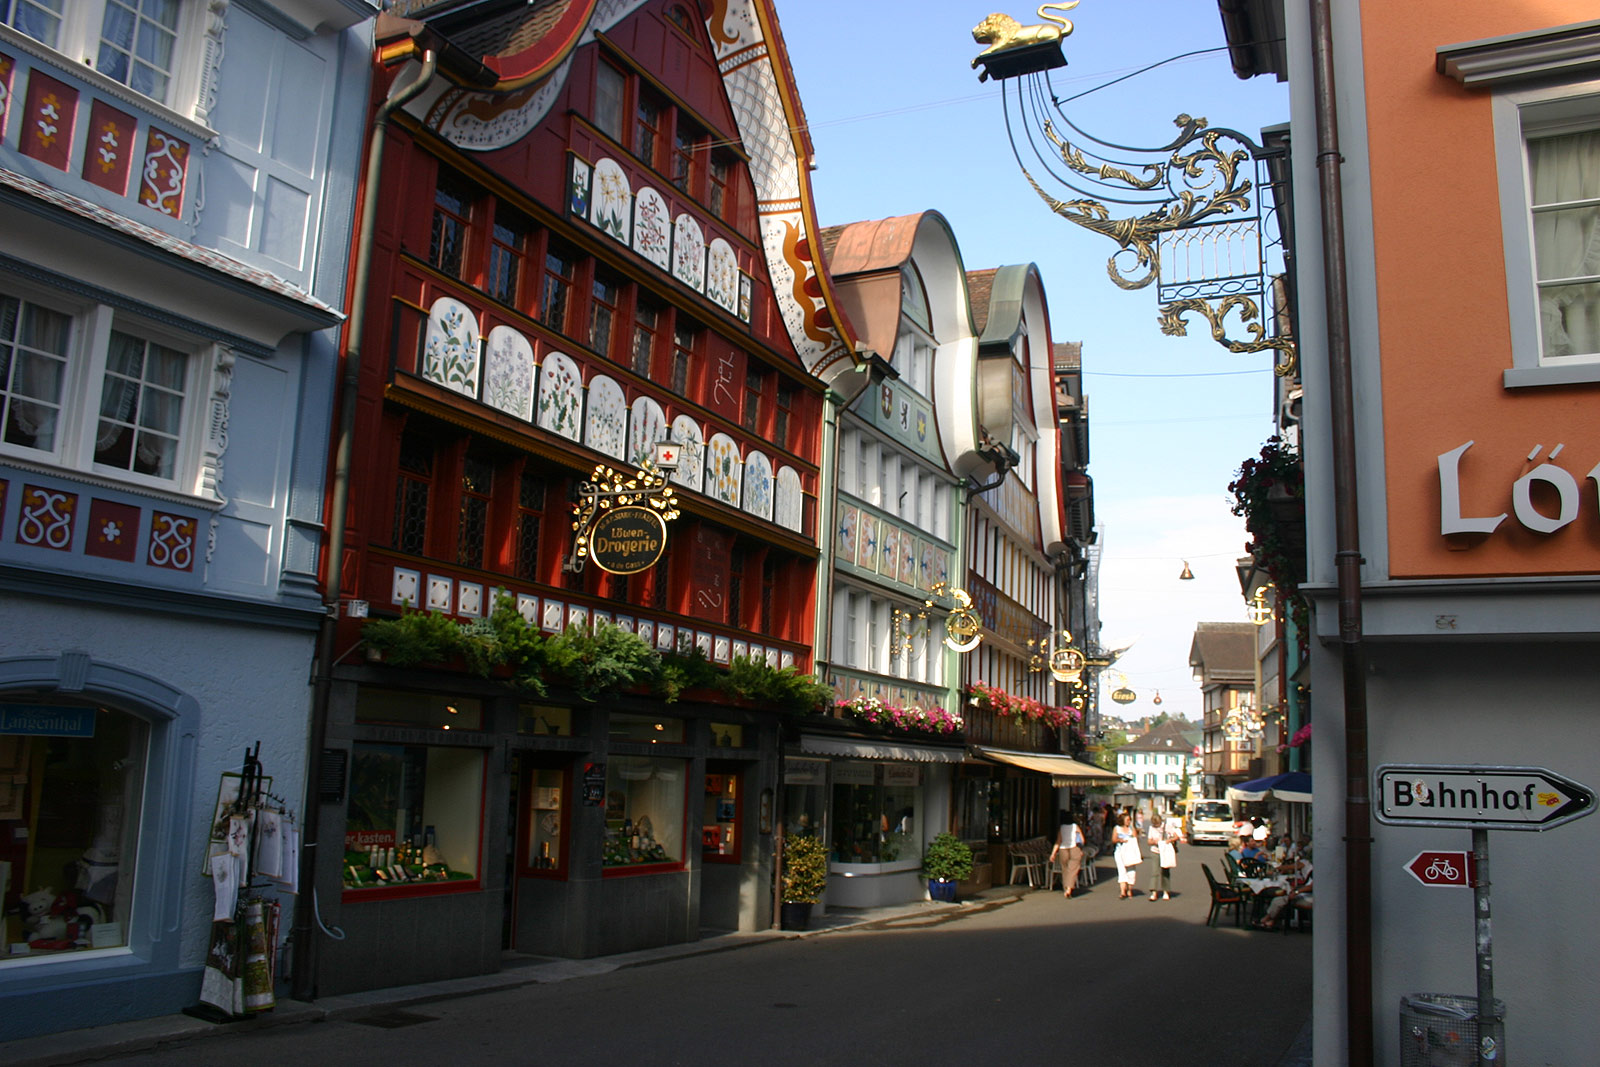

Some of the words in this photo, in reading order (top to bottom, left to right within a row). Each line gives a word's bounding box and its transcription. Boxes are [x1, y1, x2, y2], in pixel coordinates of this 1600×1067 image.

[611, 527, 649, 538] Löwen-
[597, 535, 658, 557] Drogerie
[0, 709, 82, 731] Langenthal
[1393, 781, 1536, 811] Bahnhof
[357, 832, 394, 844] kasten.
